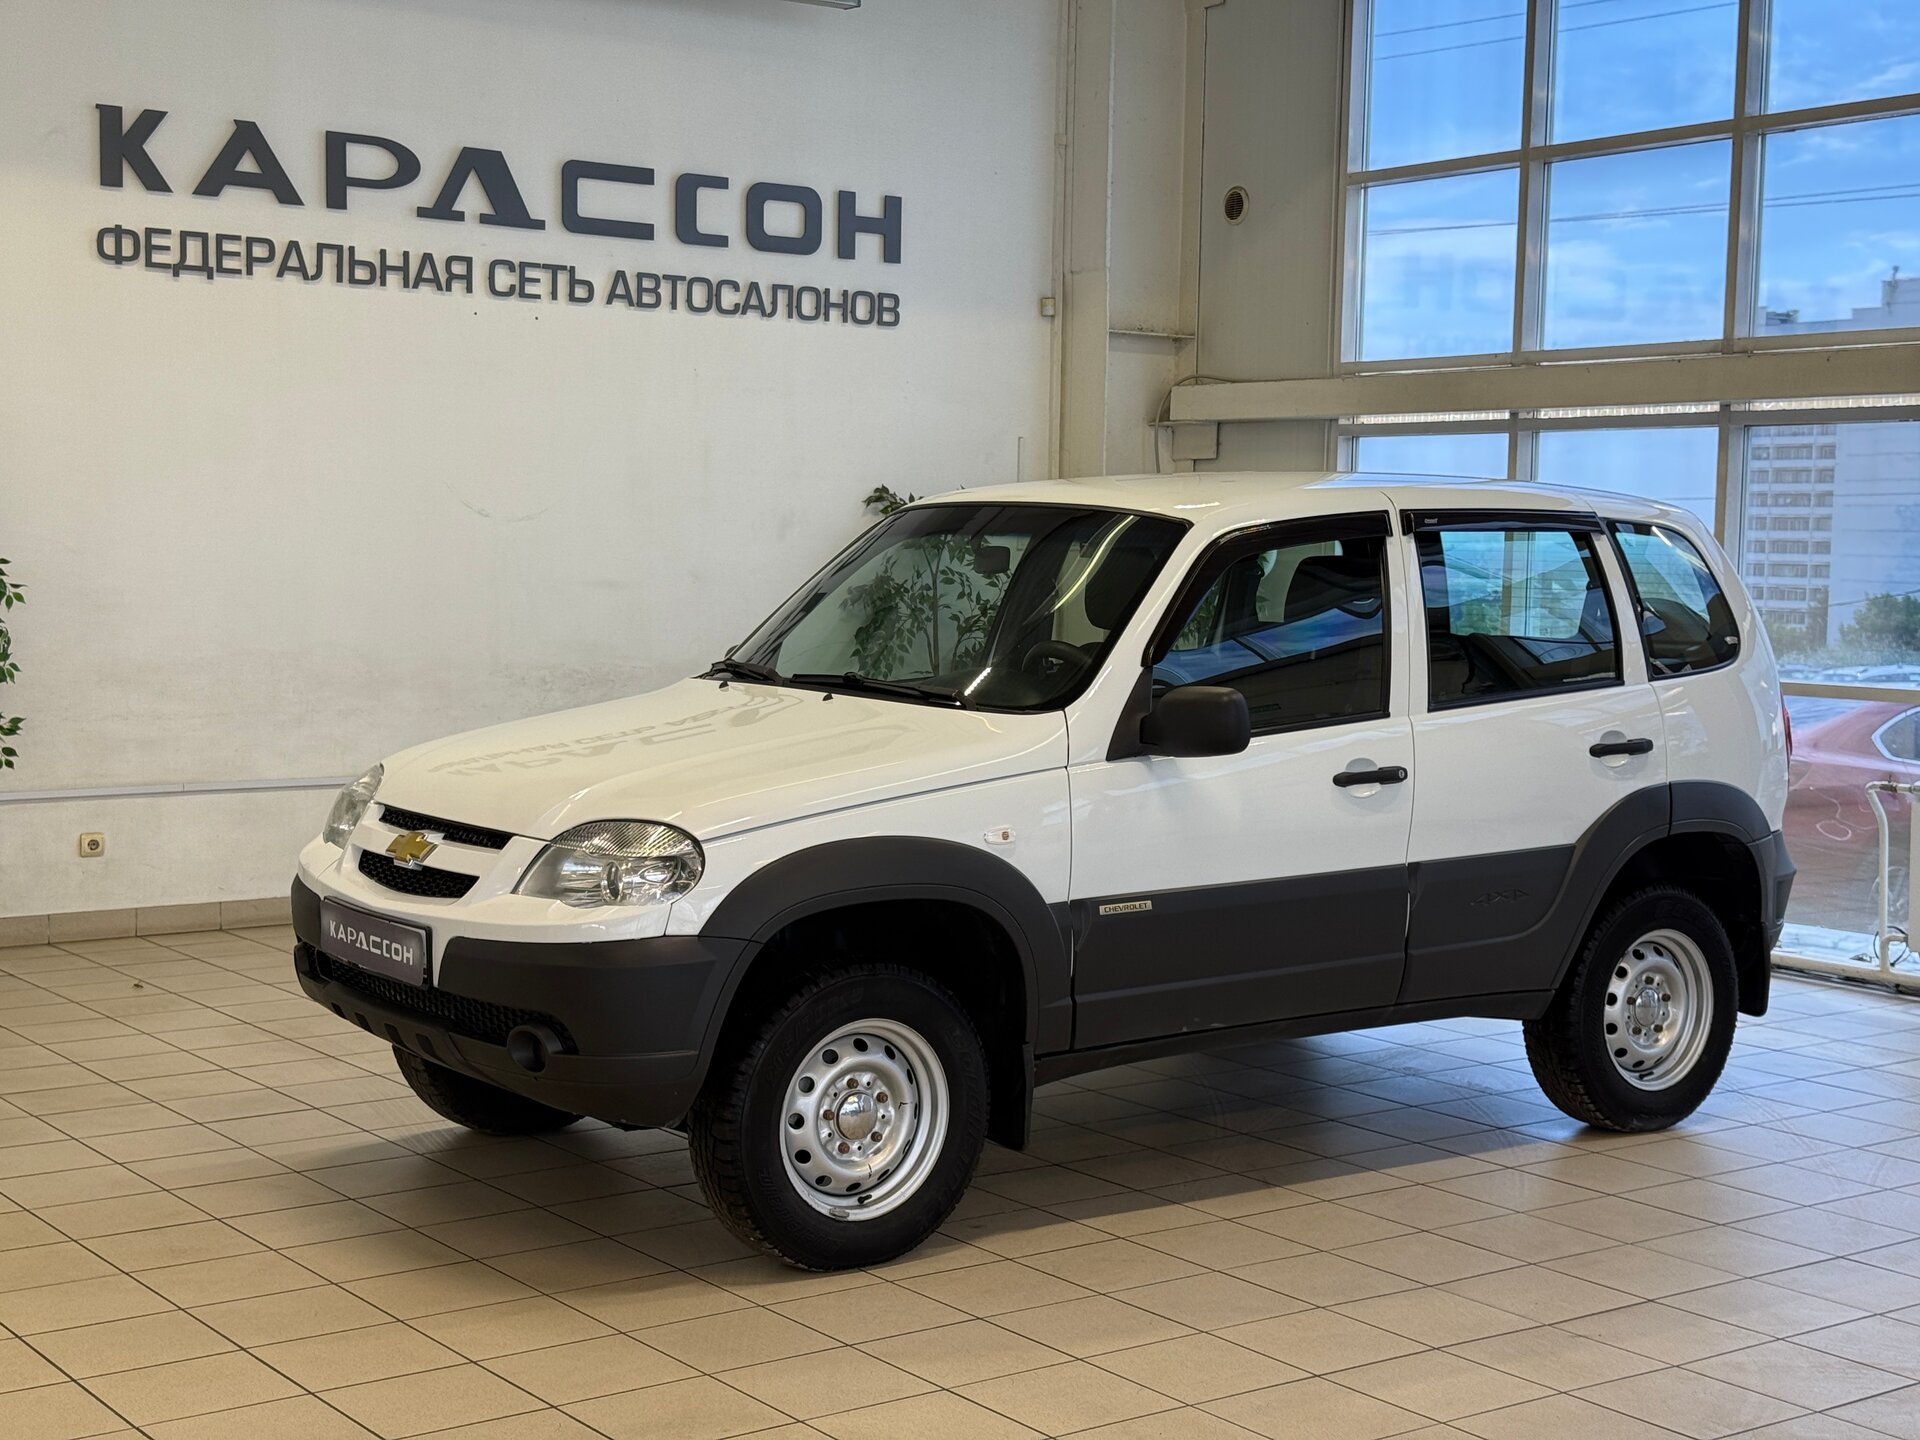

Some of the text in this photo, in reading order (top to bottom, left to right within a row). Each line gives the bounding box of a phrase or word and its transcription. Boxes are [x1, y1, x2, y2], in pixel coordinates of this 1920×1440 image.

[96, 224, 900, 327] ФЕДЕРАЛЬНАЯ СЕТЬ АВТОСАЛОНОВ
[1103, 902, 1148, 913] CHEVROLET
